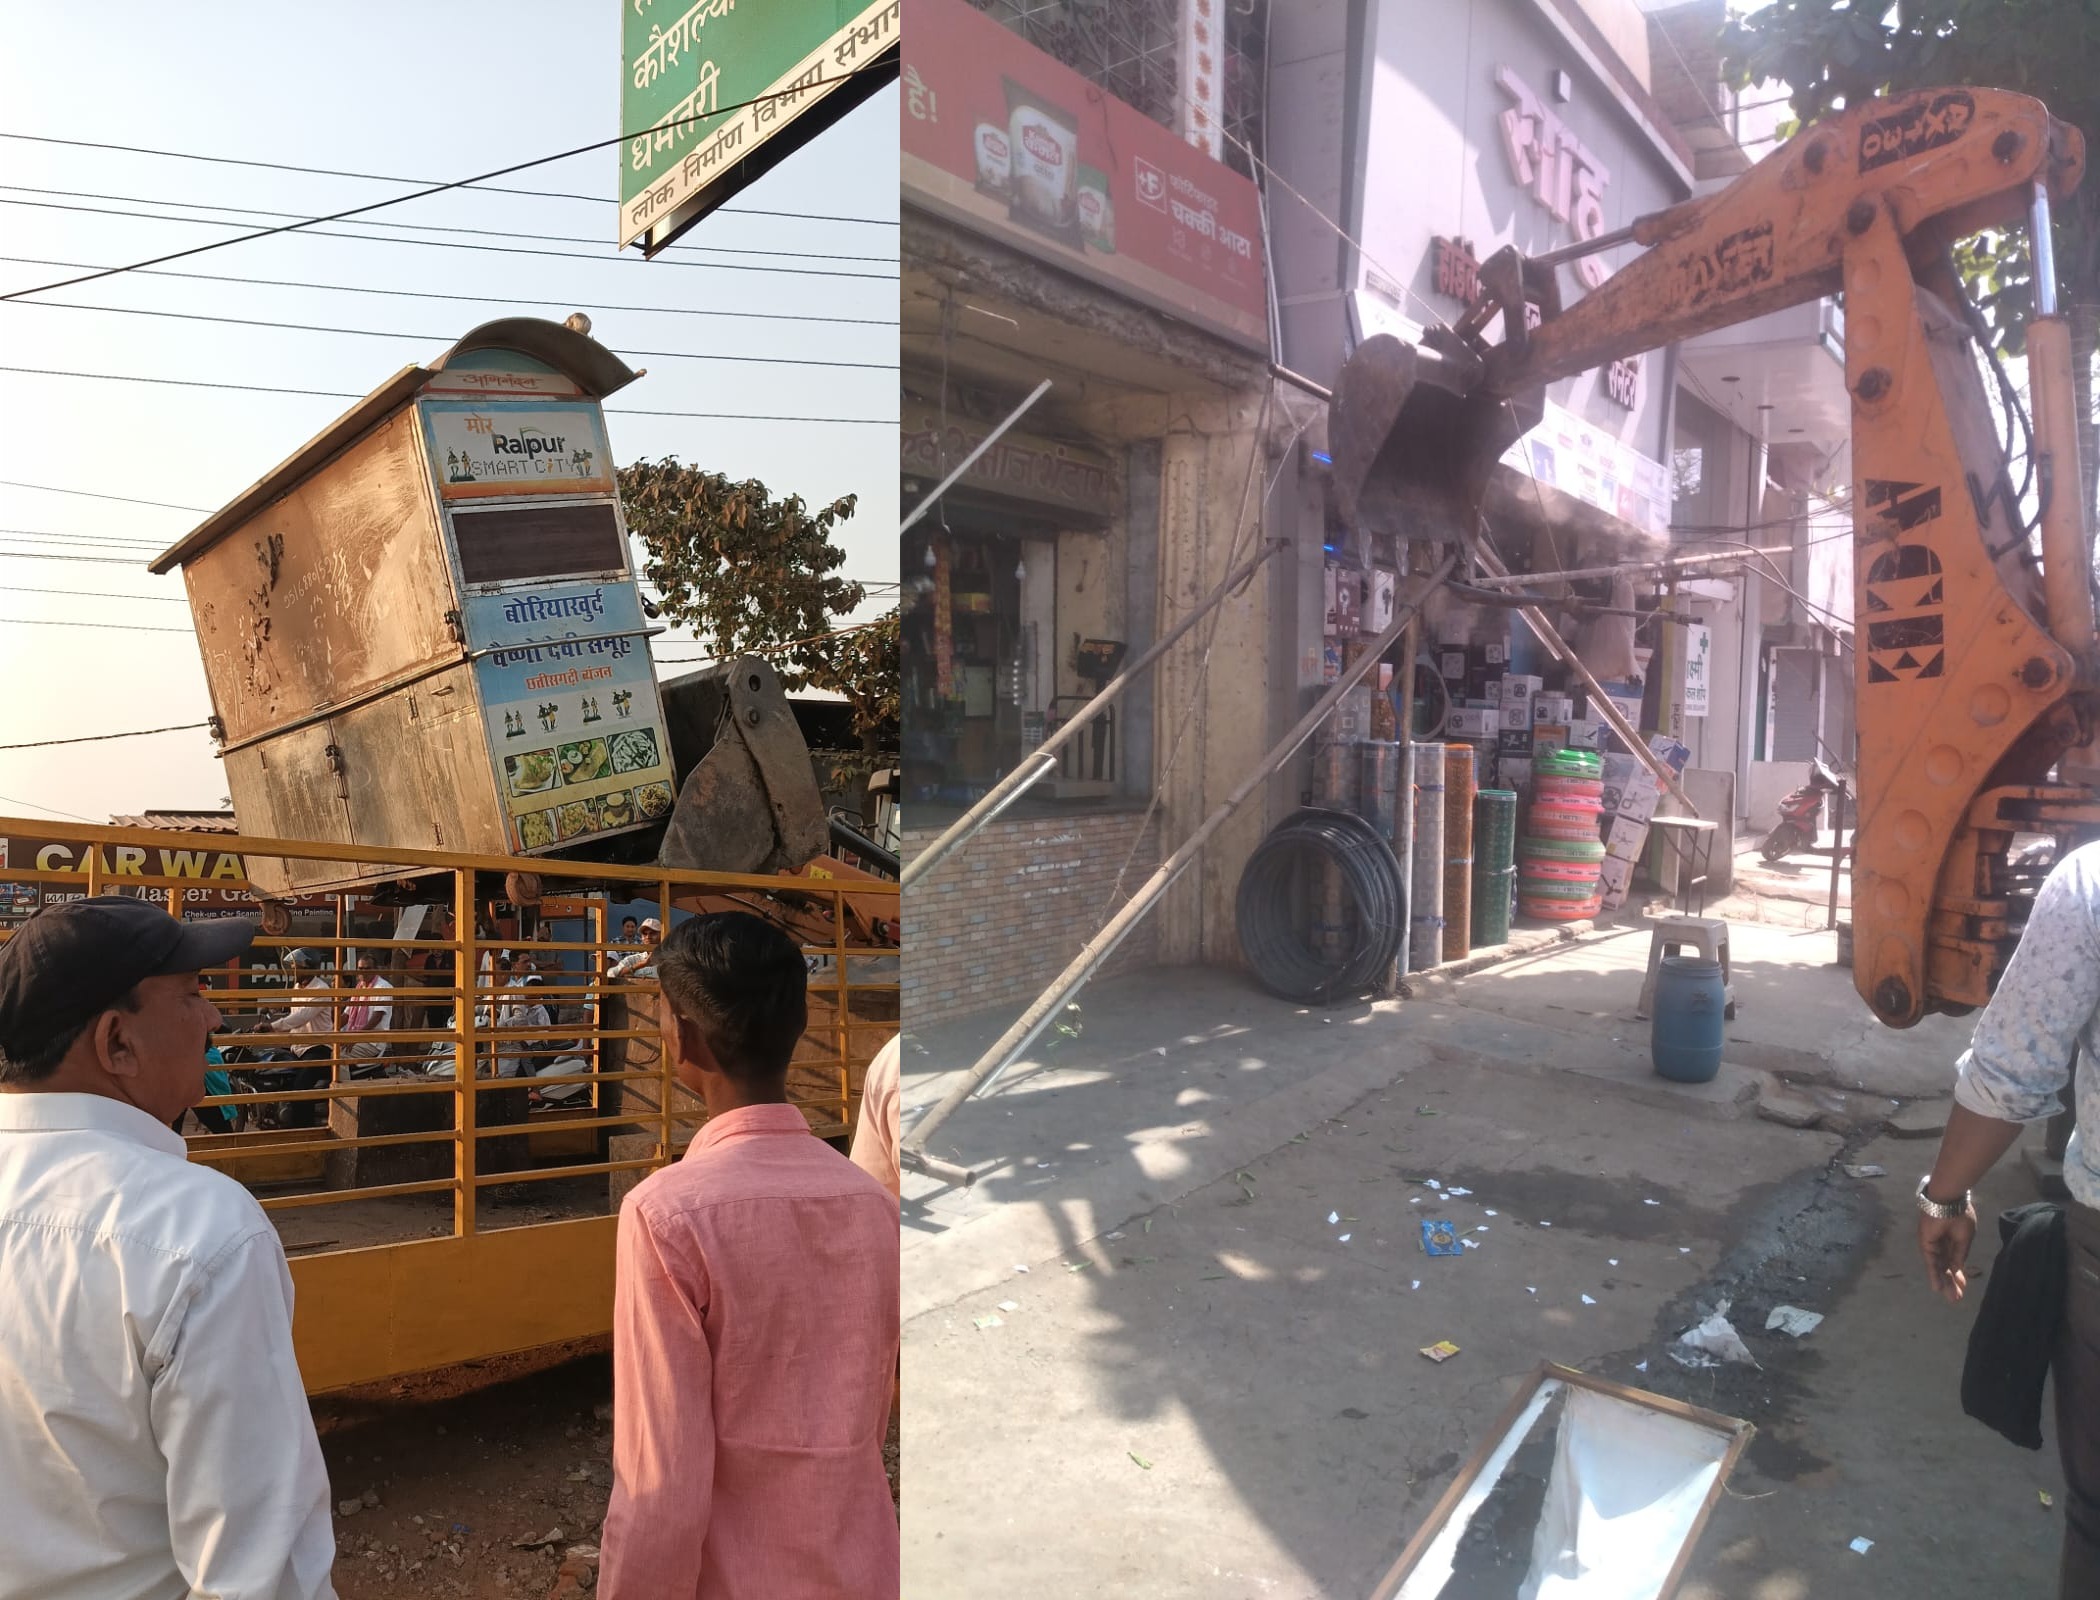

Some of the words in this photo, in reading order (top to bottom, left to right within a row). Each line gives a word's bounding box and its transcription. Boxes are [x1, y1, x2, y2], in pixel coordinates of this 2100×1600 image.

[632, 60, 721, 171] धमतरी
[631, 178, 676, 225] लोक
[683, 122, 745, 187] निर्माण
[752, 59, 826, 133] विभाग
[1170, 197, 1216, 241] चक्की
[1219, 225, 1252, 260] आटा
[464, 412, 494, 434] मोर
[493, 432, 566, 460] Raipur
[471, 459, 528, 477] SMART
[502, 587, 604, 624] बोरियाखुर्द
[36, 844, 148, 877] CAR
[160, 849, 248, 880] WA
[237, 909, 265, 919] Scanni
